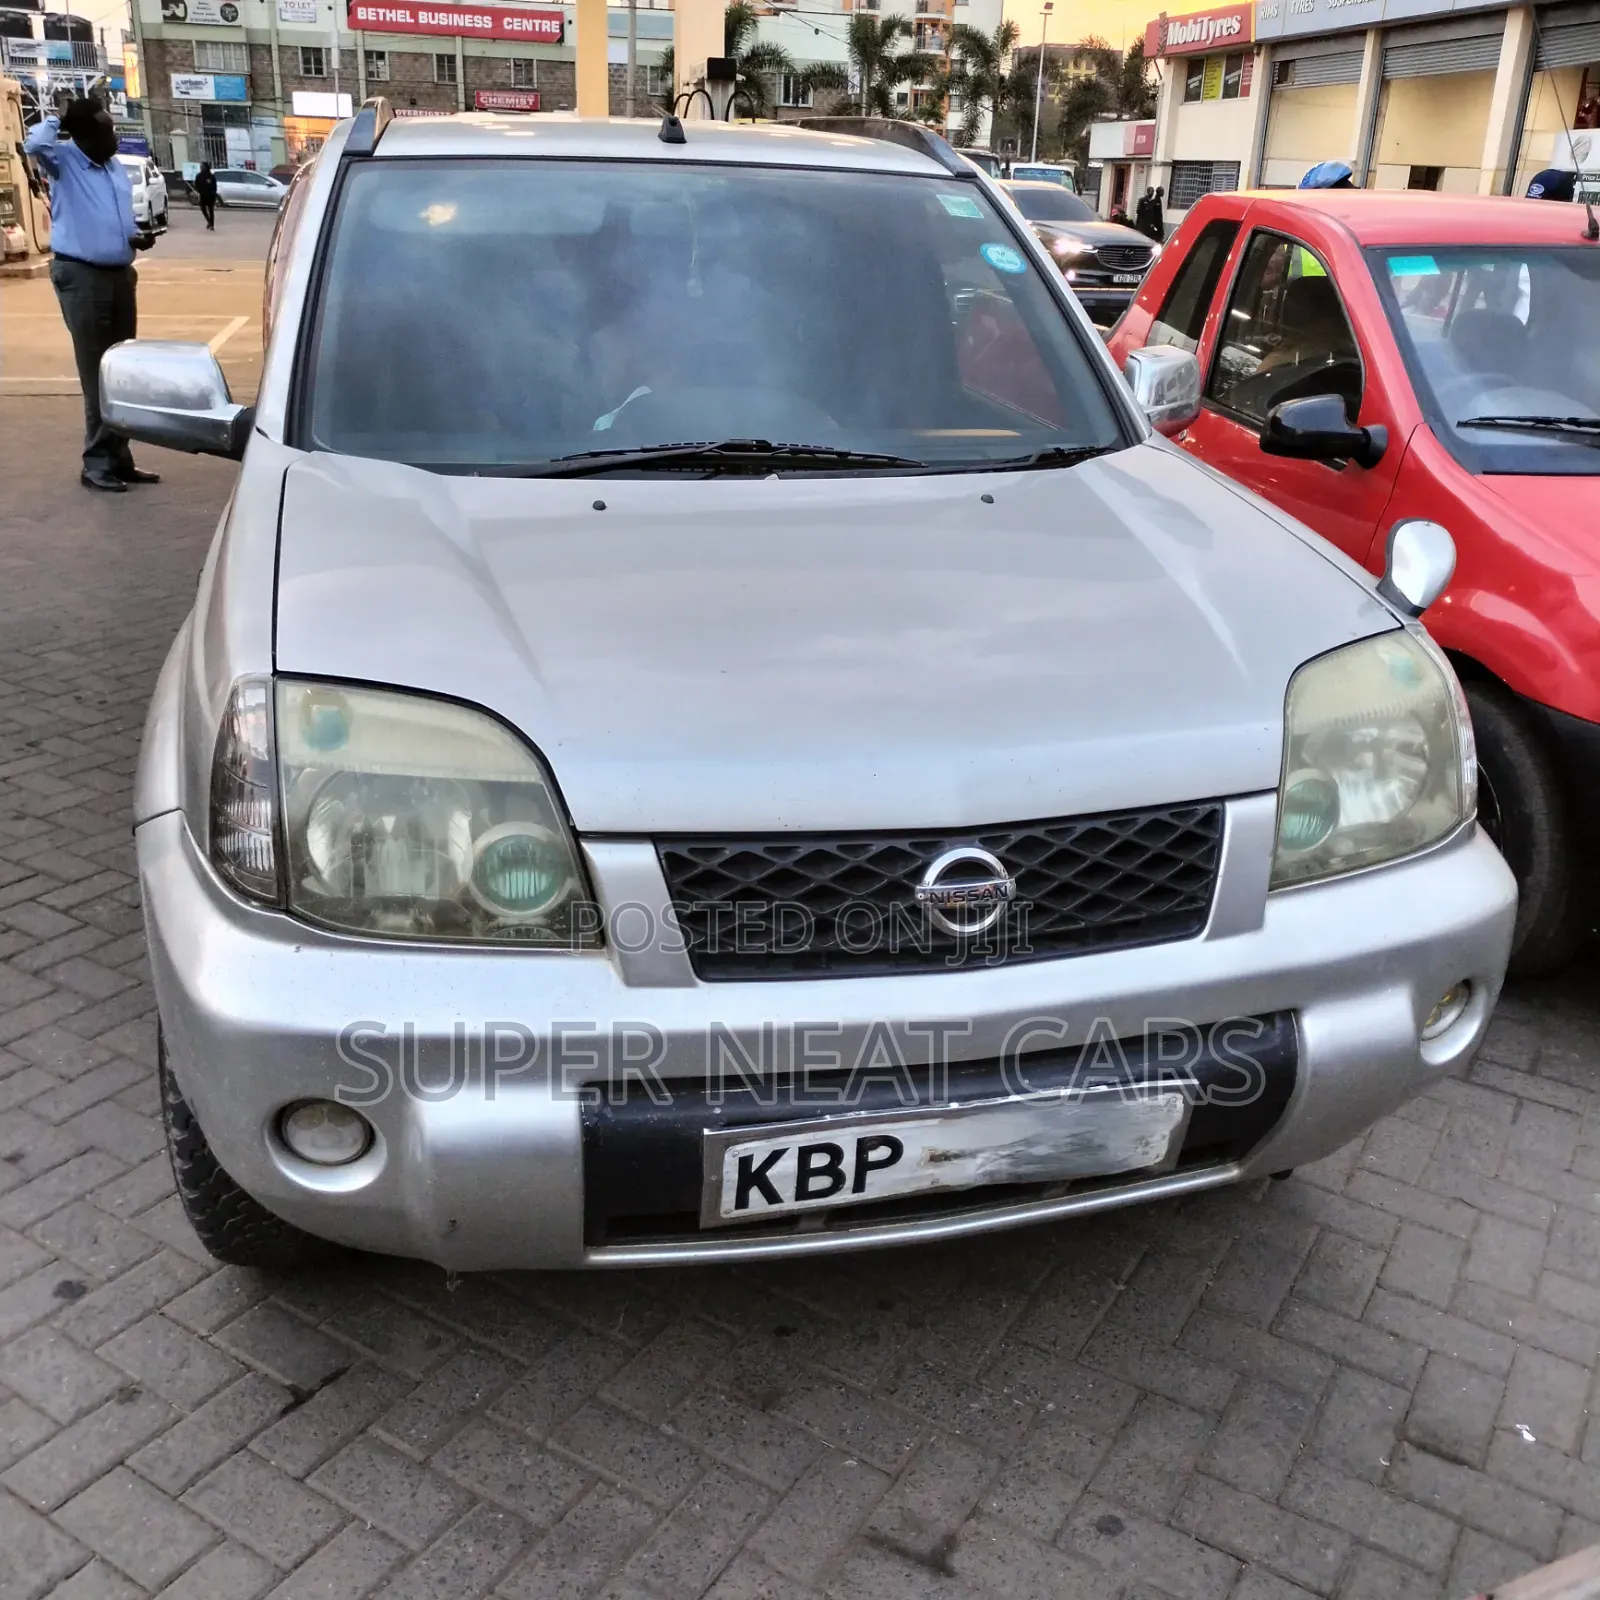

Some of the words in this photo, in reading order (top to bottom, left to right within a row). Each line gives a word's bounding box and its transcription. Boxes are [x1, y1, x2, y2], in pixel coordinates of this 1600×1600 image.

[284, 1, 296, 9] TO
[1260, 4, 1279, 20] RIMS
[1290, 0, 1315, 14] TYRES
[357, 7, 414, 23] BETHEL
[418, 11, 493, 28] BUSINESS
[503, 17, 560, 33] CENTRE
[1166, 15, 1242, 45] MobiTyres
[480, 96, 535, 106] CHEMIST
[929, 885, 1008, 904] NISSAN
[734, 1134, 904, 1210] KBP
